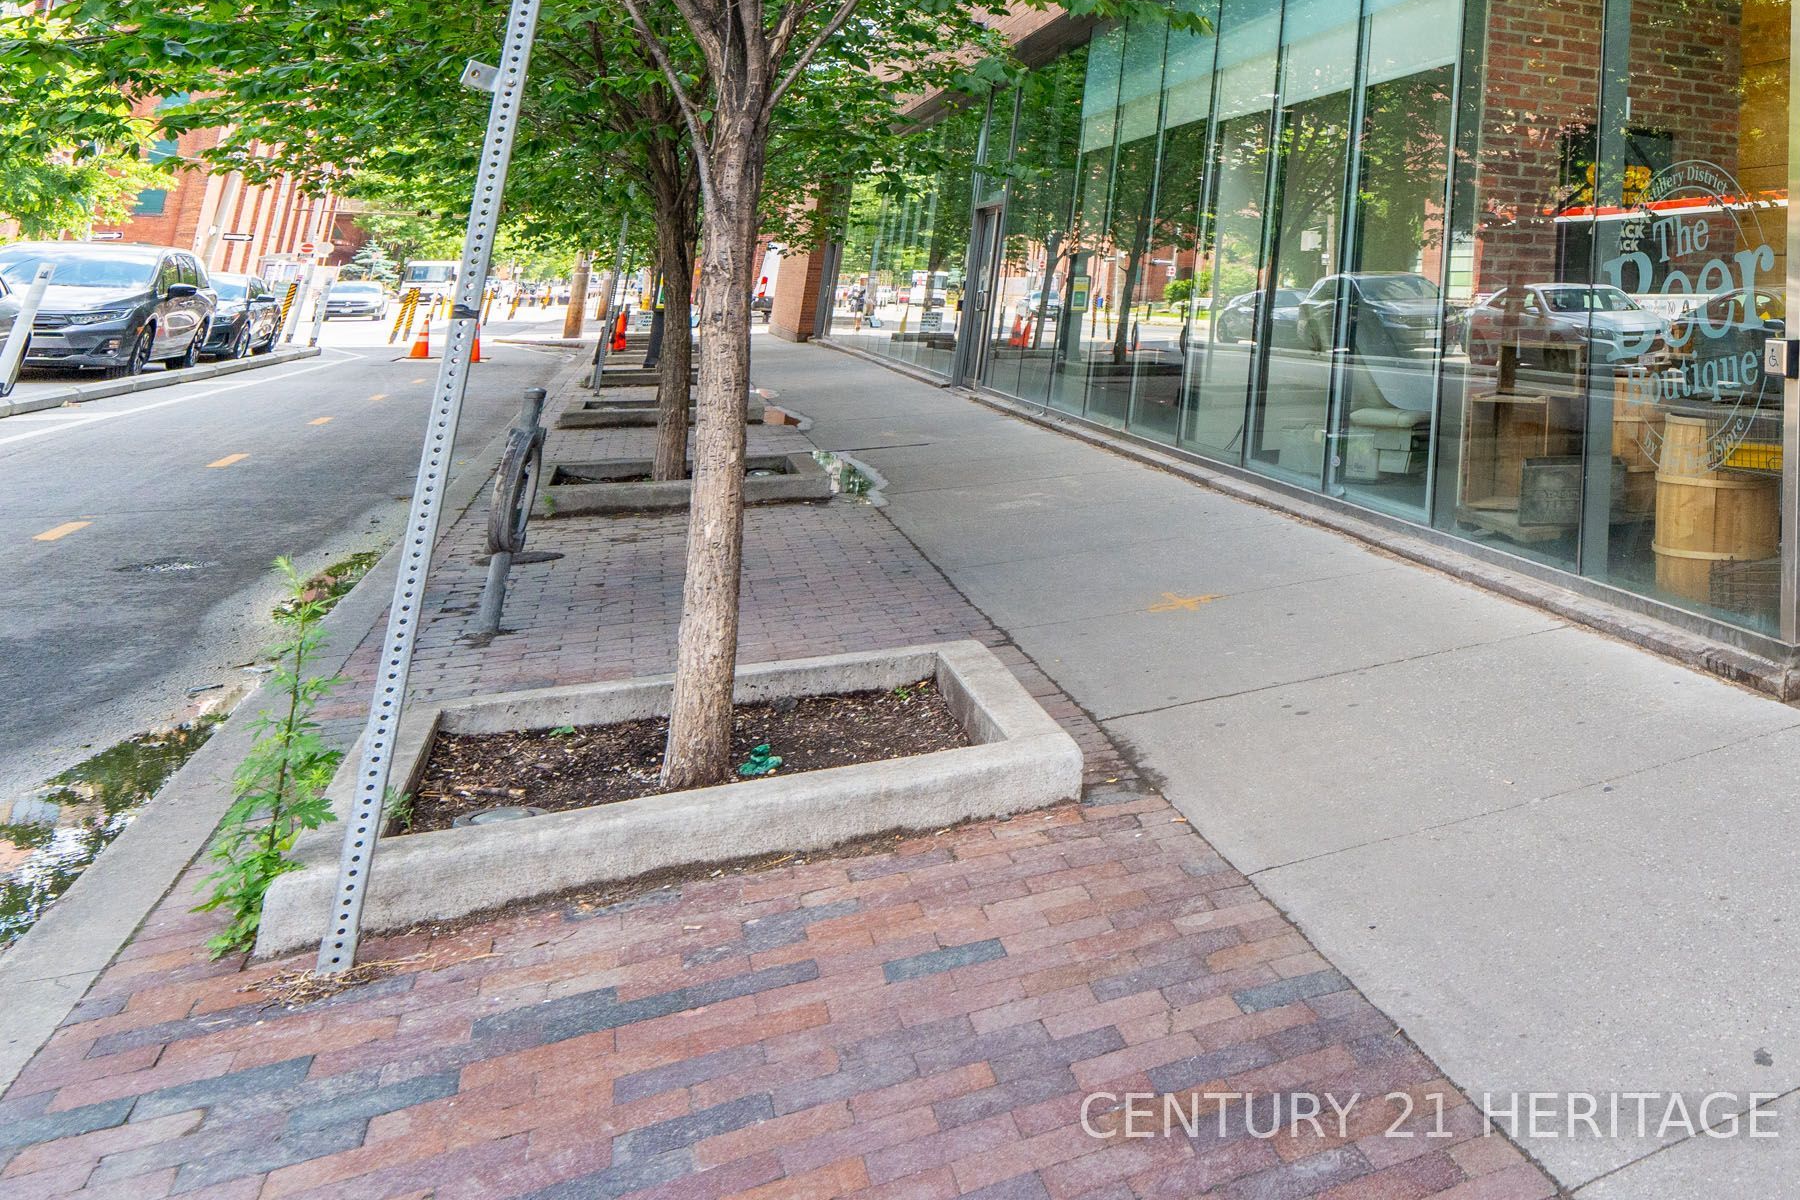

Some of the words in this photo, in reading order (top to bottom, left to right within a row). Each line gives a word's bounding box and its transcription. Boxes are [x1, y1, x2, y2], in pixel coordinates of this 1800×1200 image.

[1687, 166, 1728, 195] District
[1652, 214, 1710, 263] The
[1602, 244, 1775, 363] Beer
[1625, 349, 1759, 406] Boutique
[1715, 417, 1745, 458] Store
